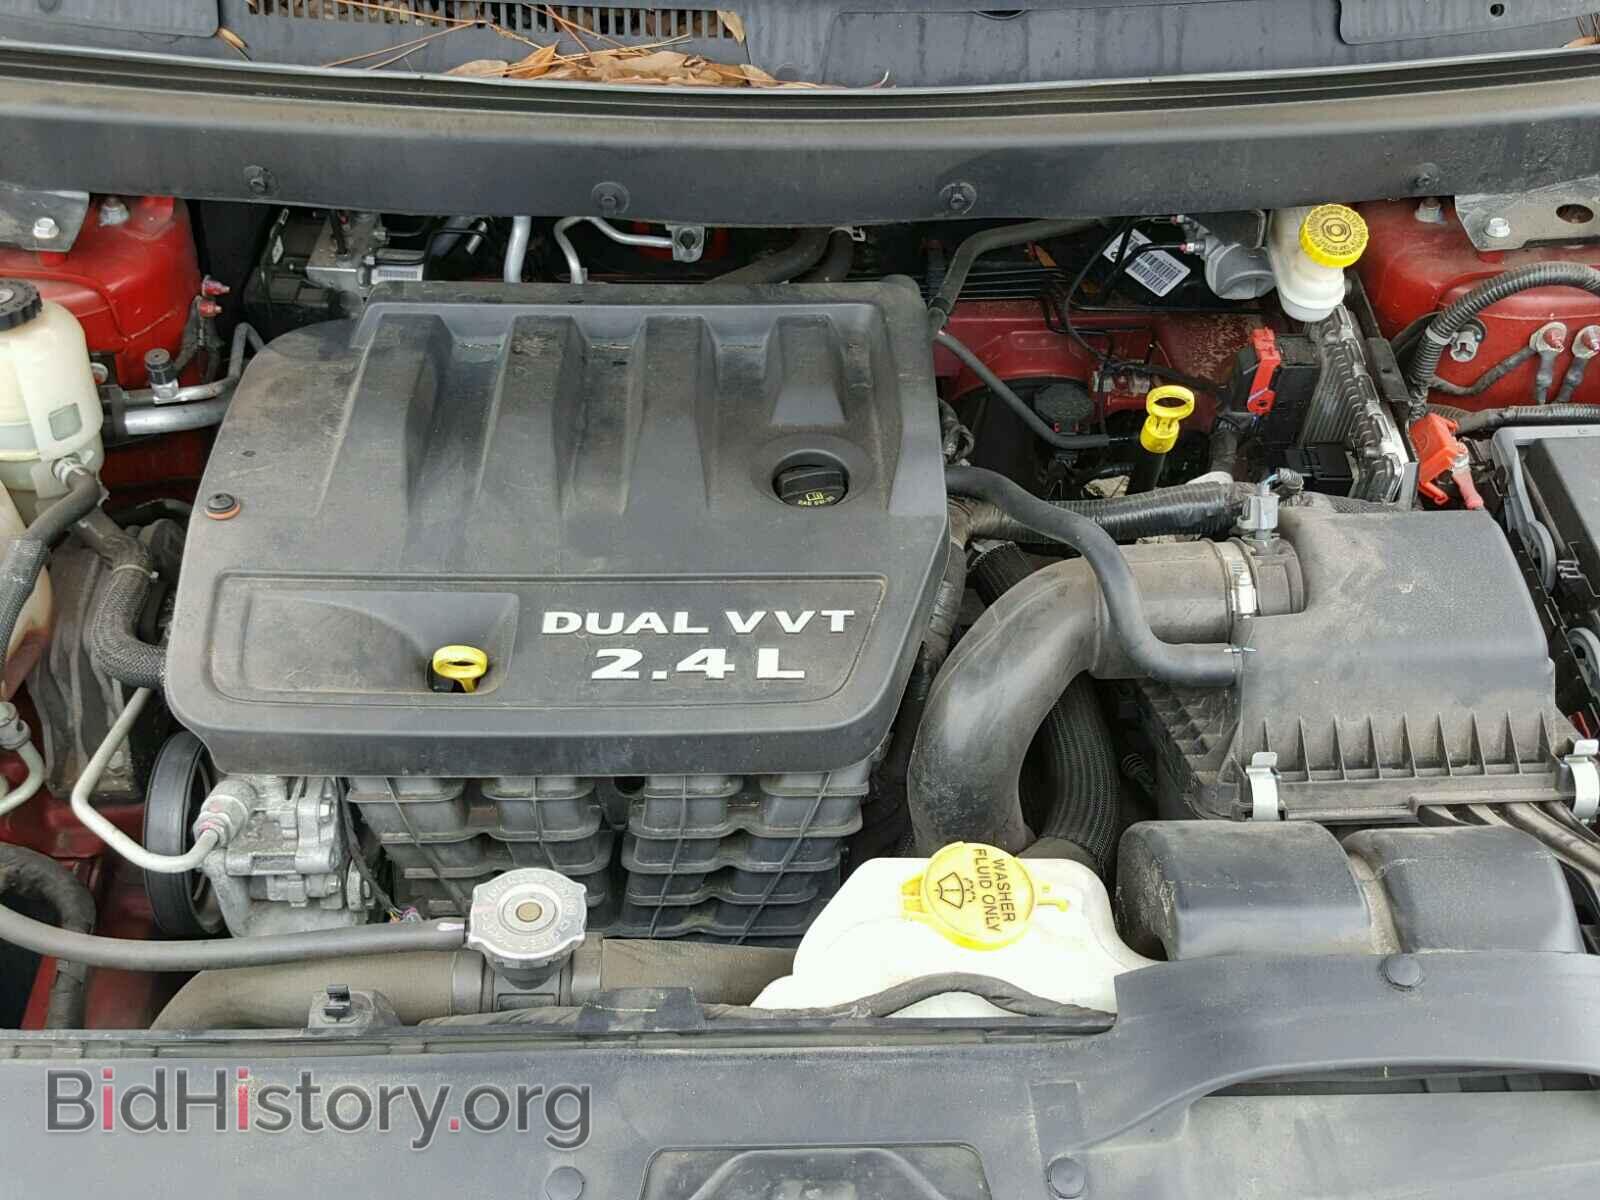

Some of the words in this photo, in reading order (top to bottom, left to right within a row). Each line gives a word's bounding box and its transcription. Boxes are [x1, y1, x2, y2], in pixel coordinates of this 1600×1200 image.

[542, 611, 709, 635] DUAL
[725, 610, 855, 634] VVT
[973, 848, 993, 889] FLUID
[992, 858, 1016, 922] WASHER
[982, 894, 1002, 932] ONLY
